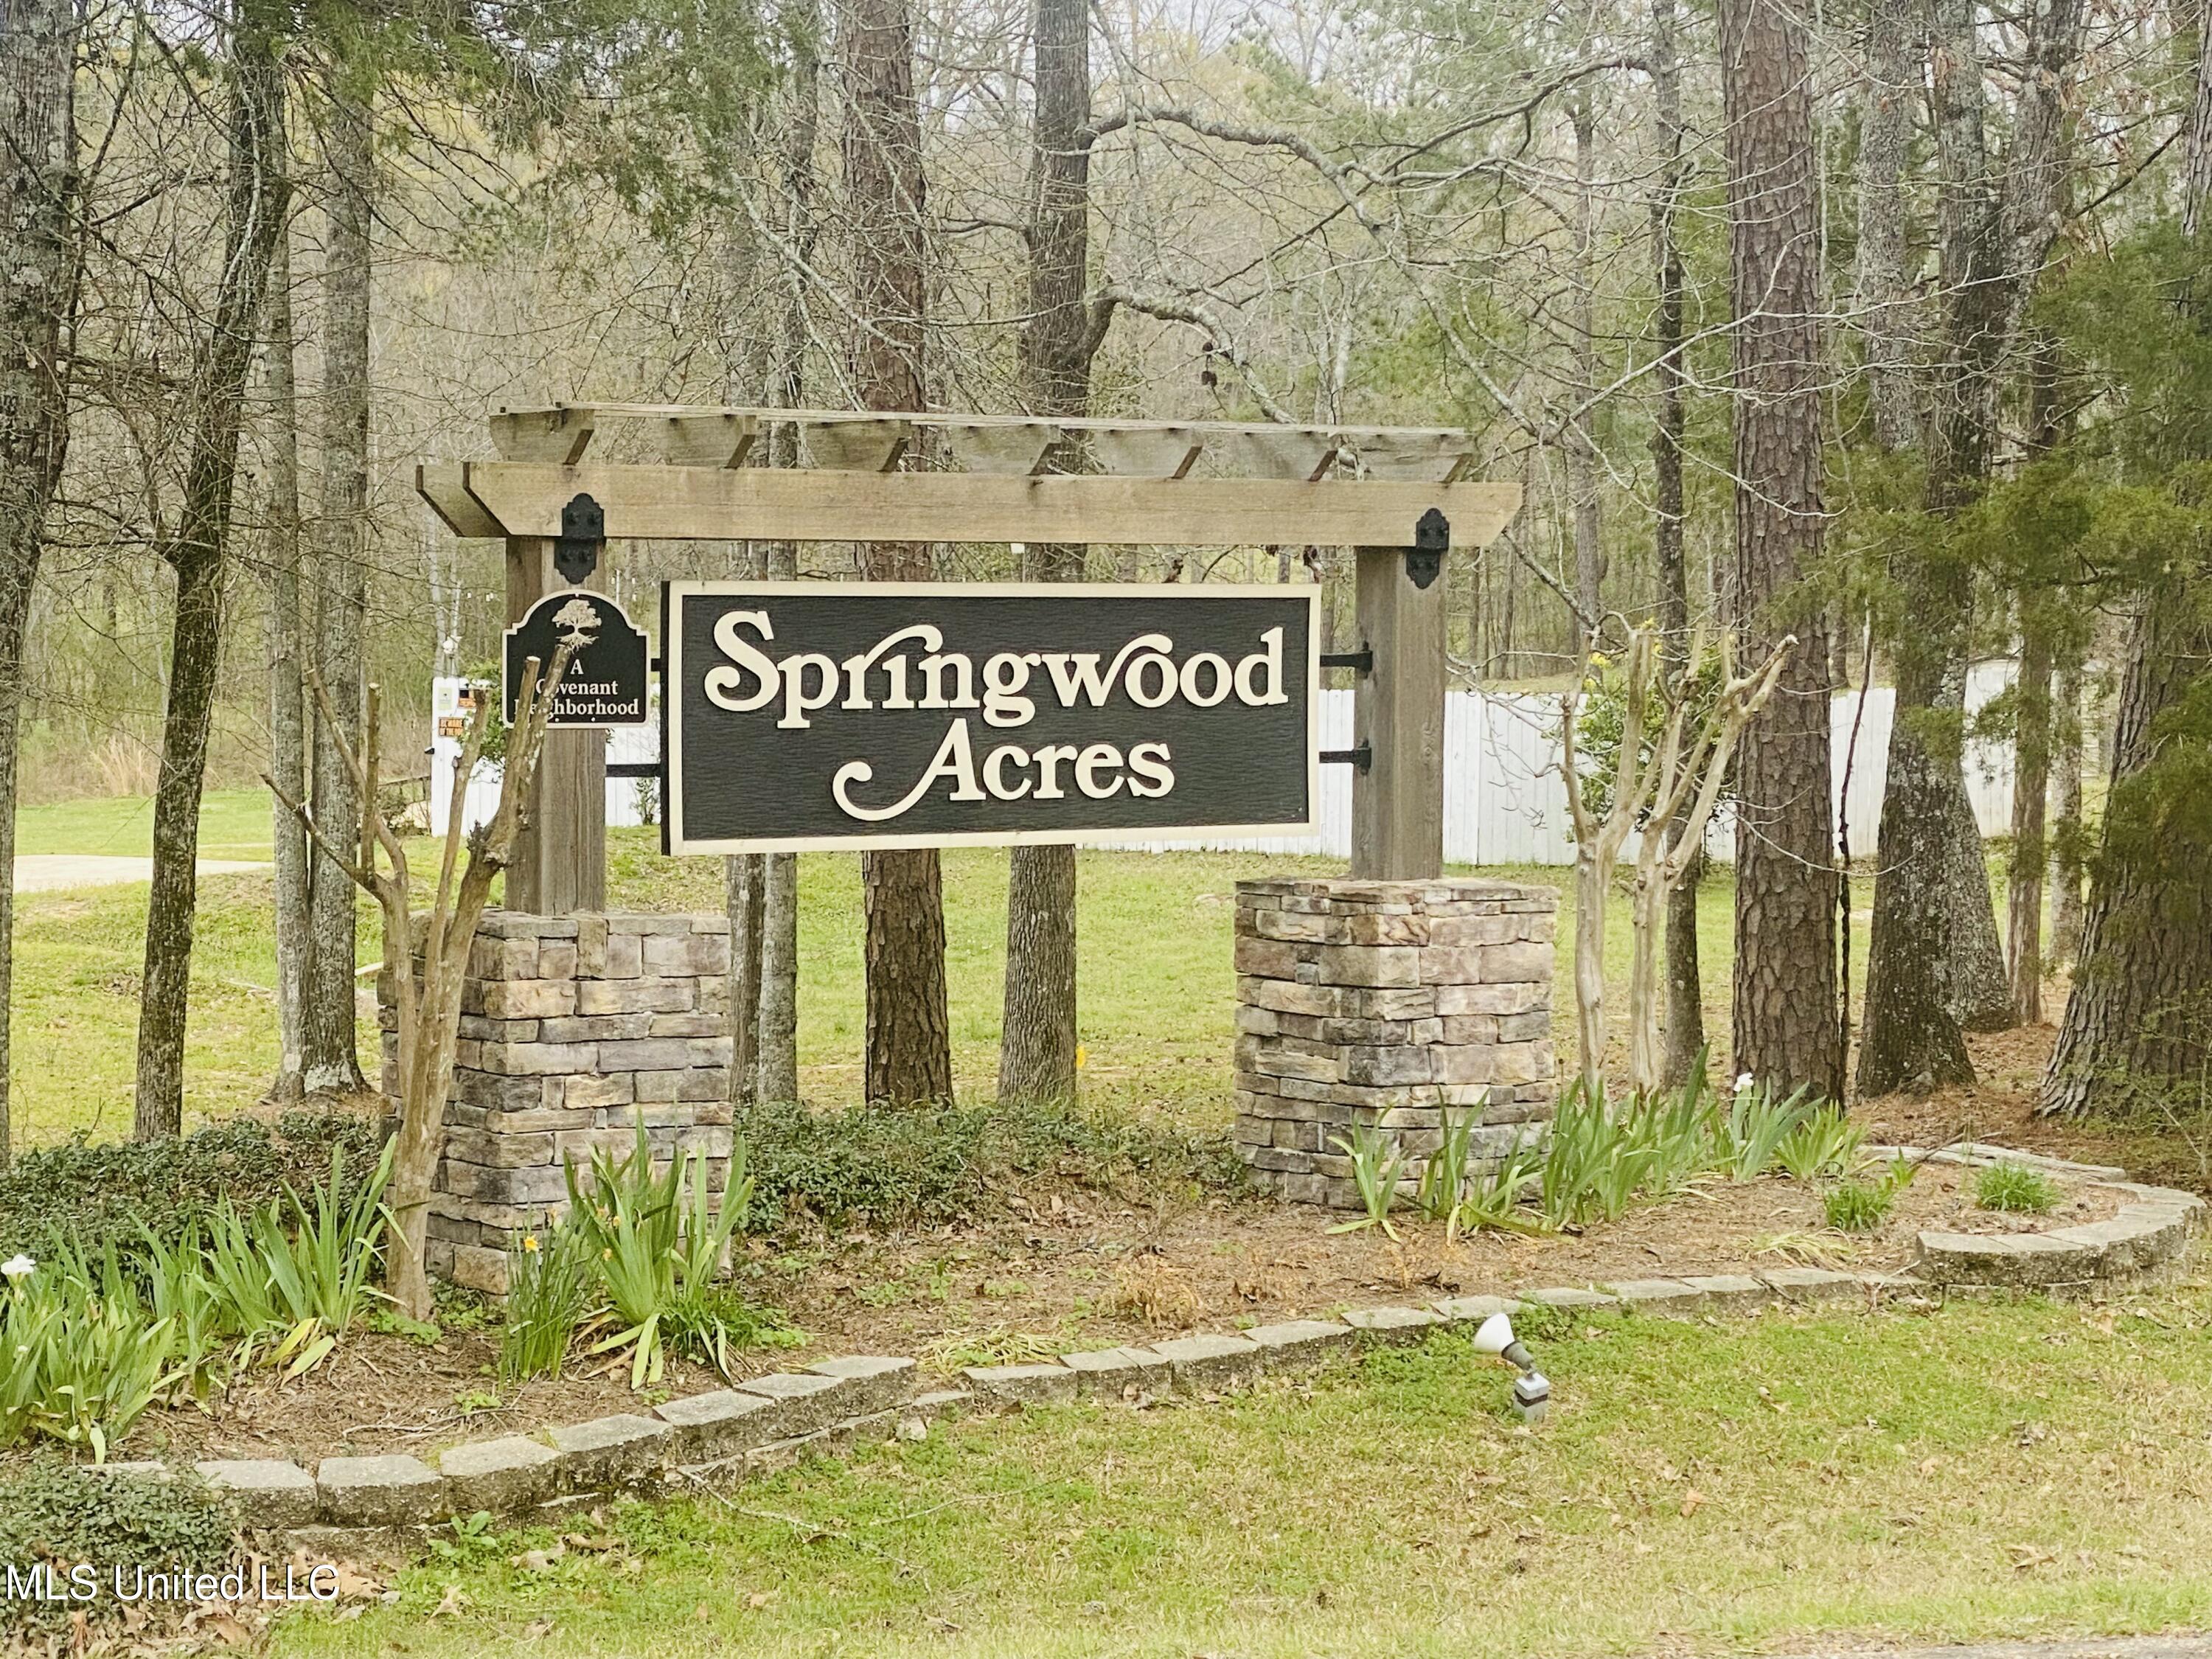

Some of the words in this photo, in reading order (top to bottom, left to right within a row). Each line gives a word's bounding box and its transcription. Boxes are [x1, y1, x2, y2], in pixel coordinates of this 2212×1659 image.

[535, 678, 619, 695] Cvenant
[570, 658, 584, 675] A
[704, 611, 1290, 729] Springwood
[832, 717, 1175, 821] Acres
